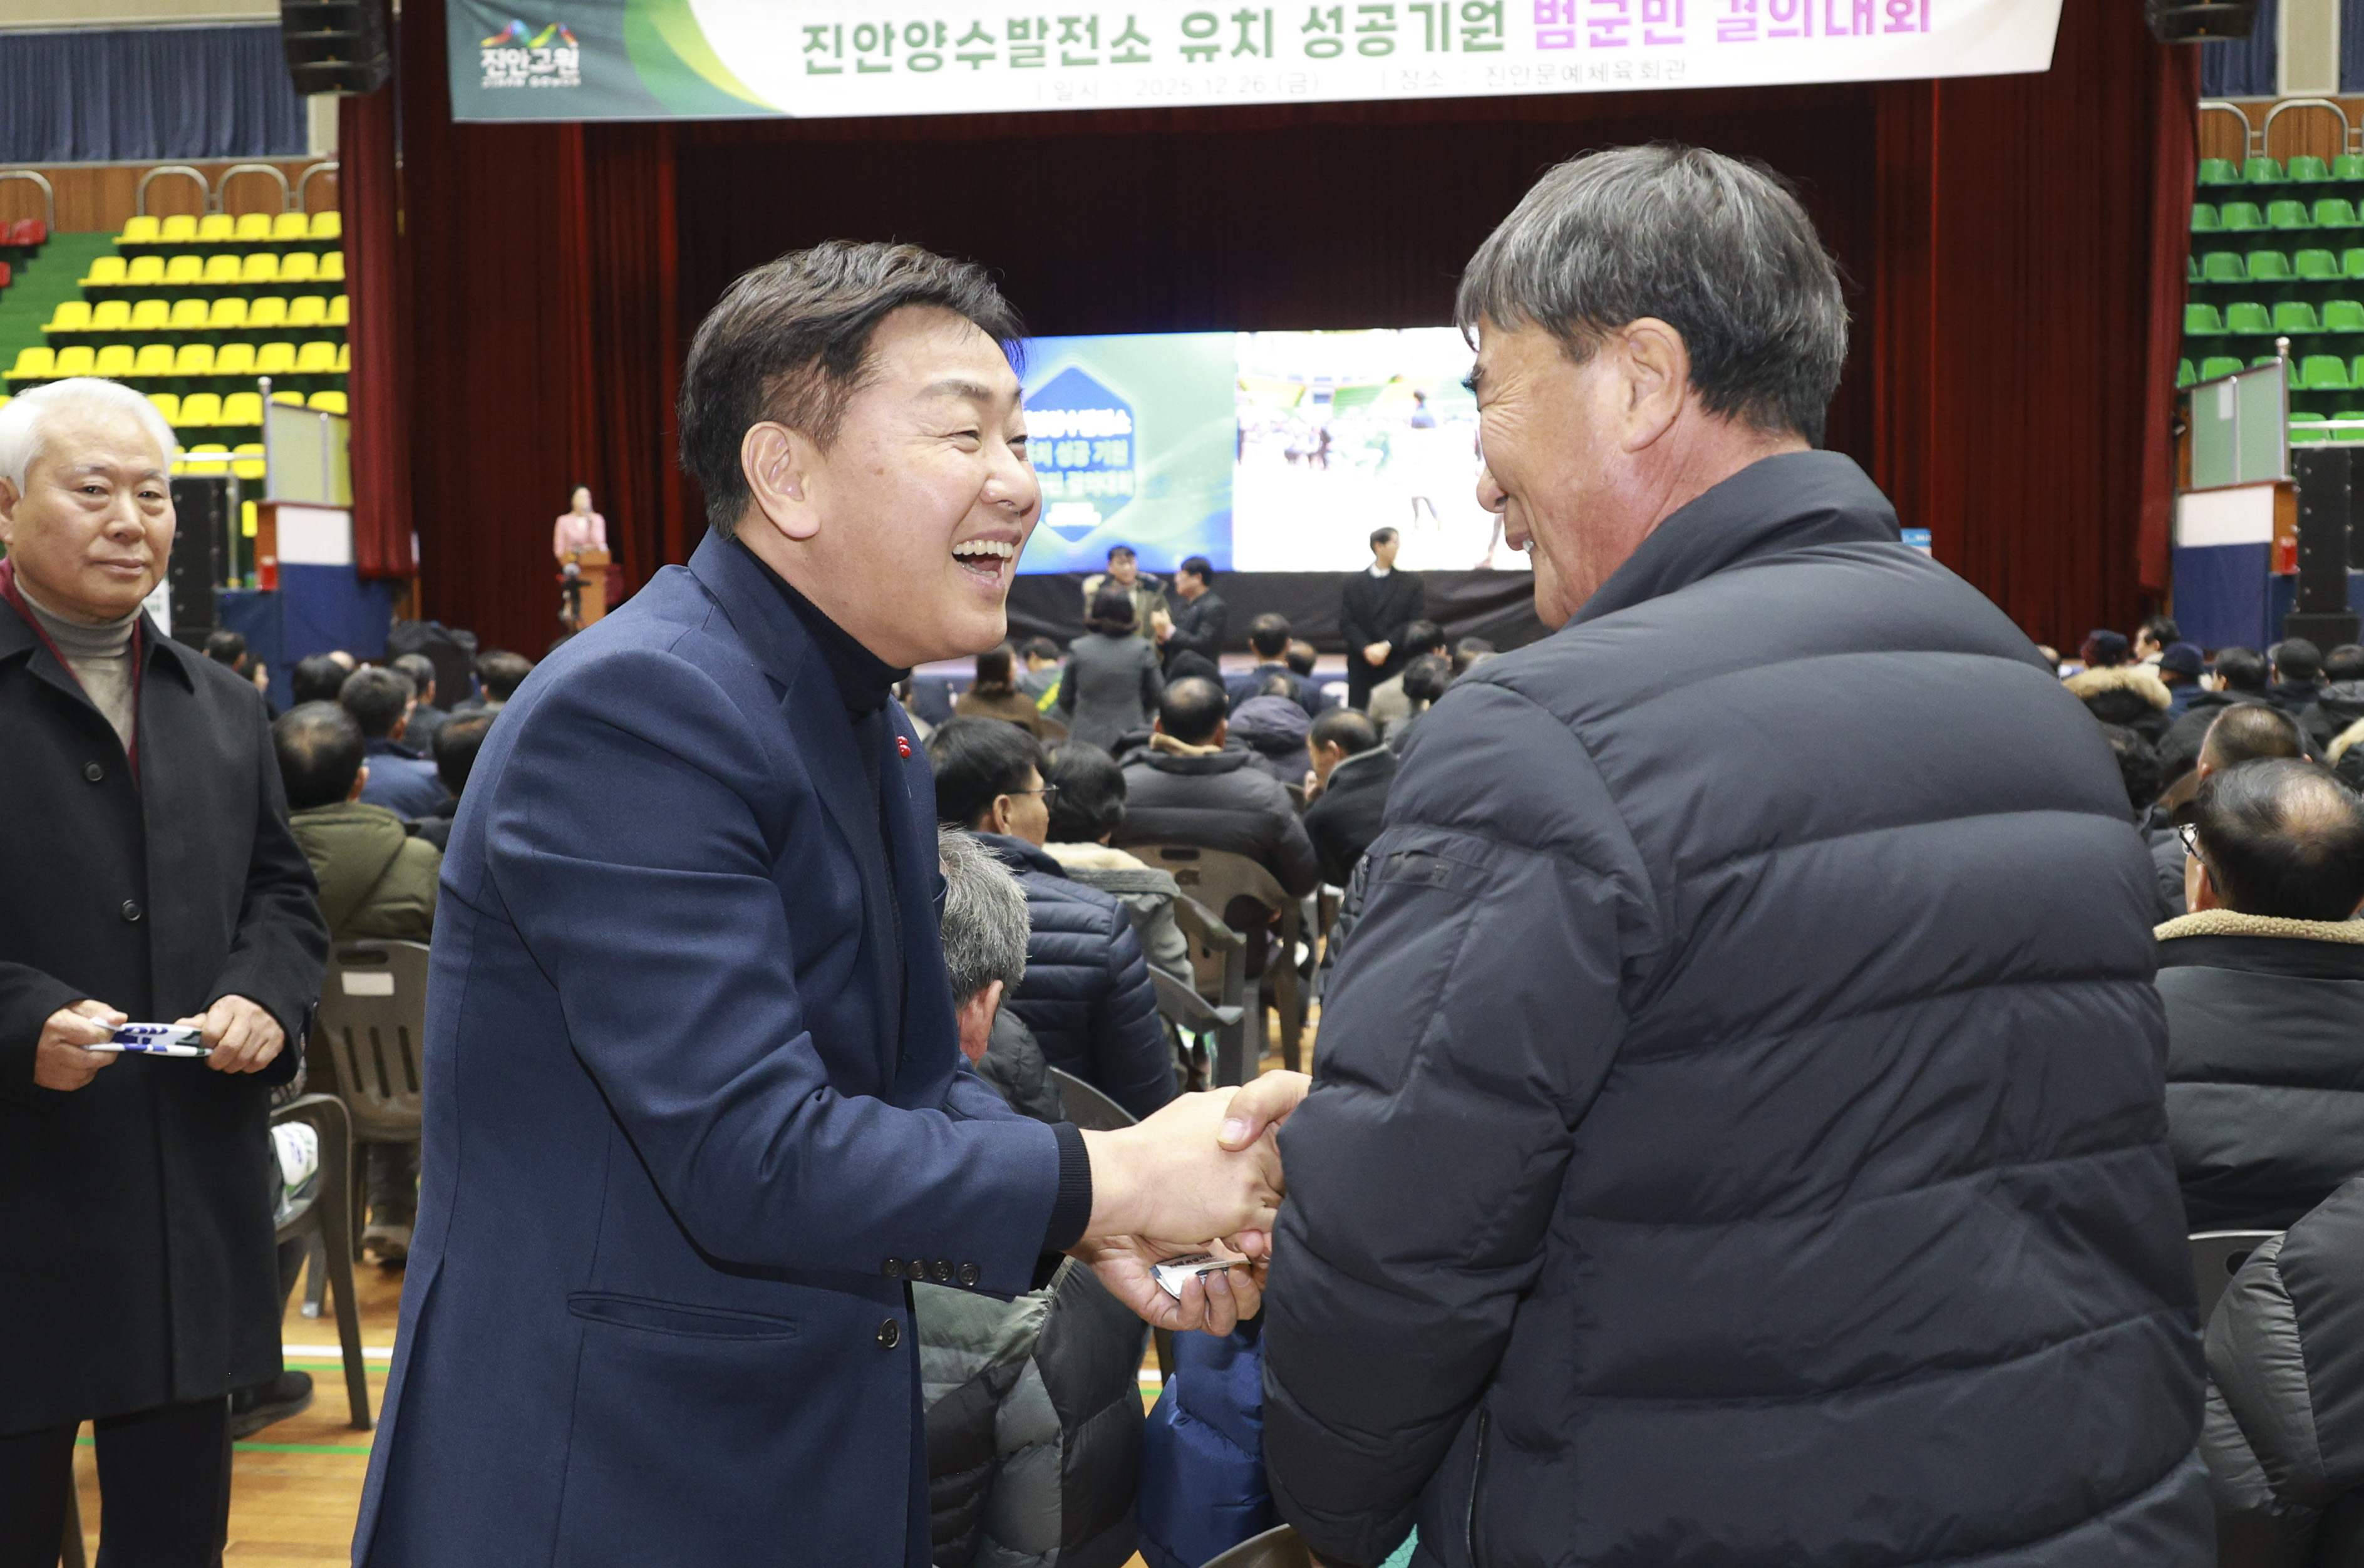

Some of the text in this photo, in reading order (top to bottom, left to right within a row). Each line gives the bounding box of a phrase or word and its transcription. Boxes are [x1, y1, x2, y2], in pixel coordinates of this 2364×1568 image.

[802, 14, 1152, 75] 진안양수발전소
[1179, 7, 1273, 63] 유치
[1301, 0, 1505, 59] 성공기원
[1534, 0, 1685, 49] 범군민
[480, 48, 580, 76] 진안고원
[1053, 79, 1100, 102] 일시
[1398, 68, 1446, 91] 장소
